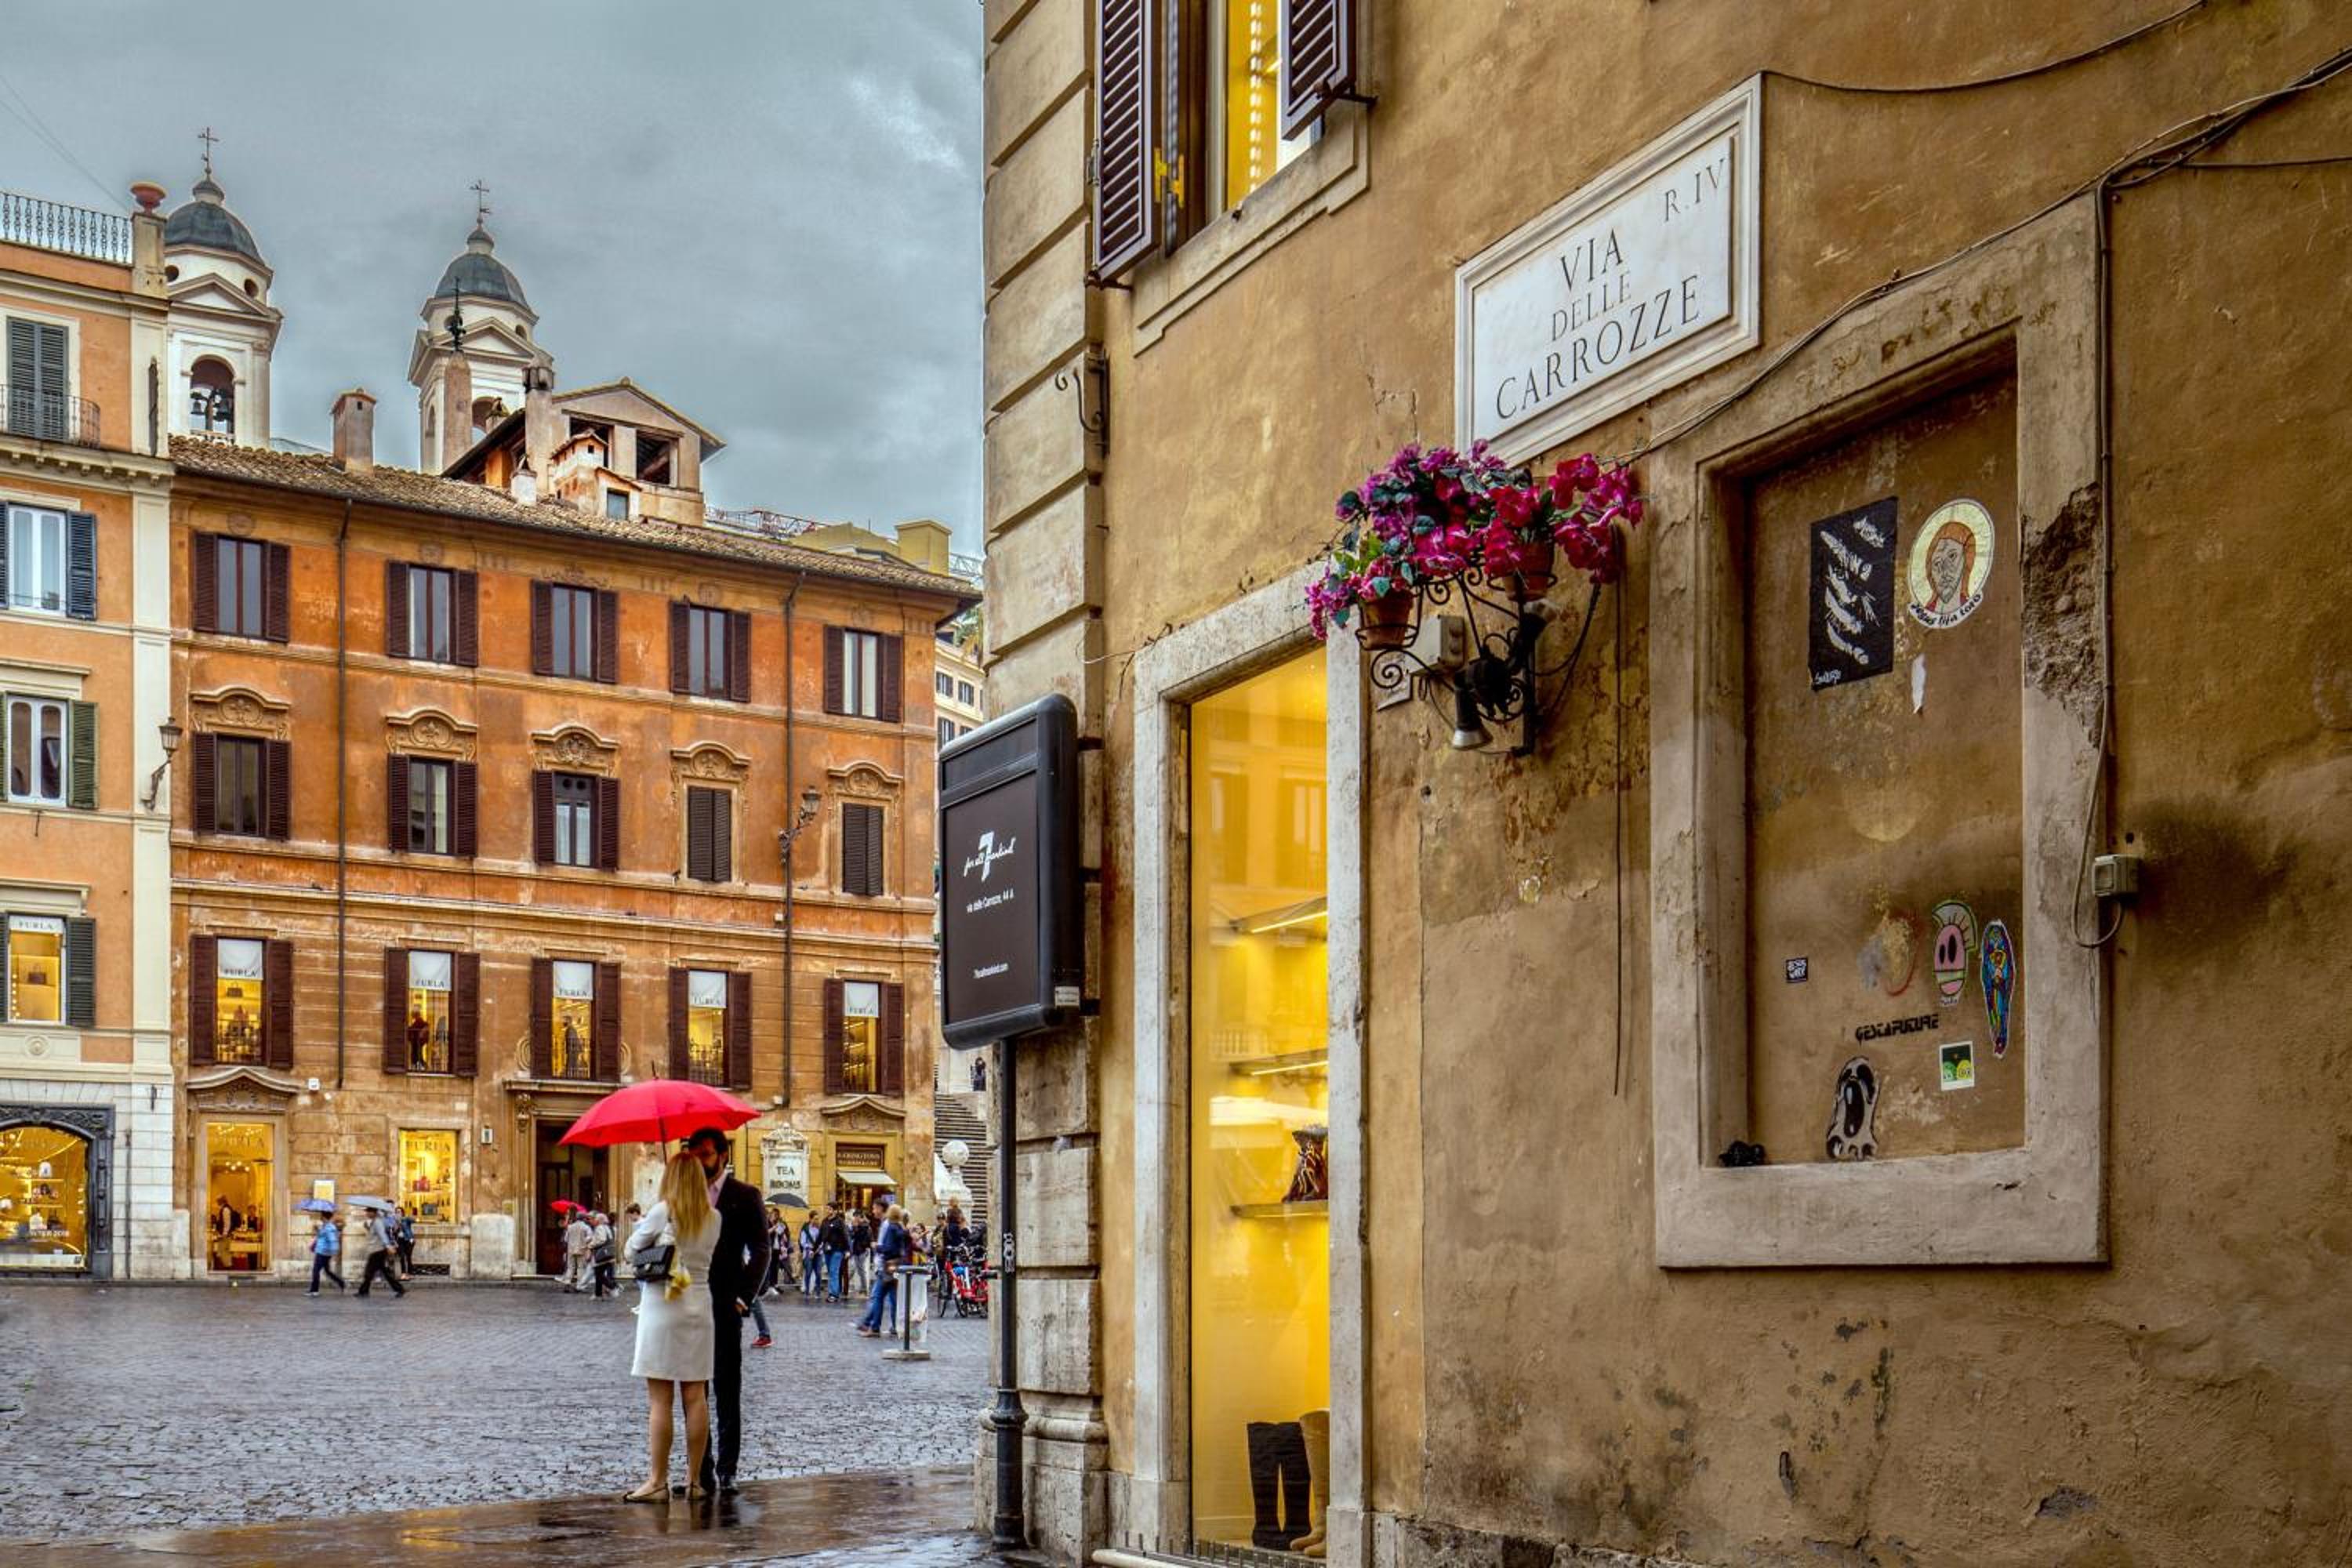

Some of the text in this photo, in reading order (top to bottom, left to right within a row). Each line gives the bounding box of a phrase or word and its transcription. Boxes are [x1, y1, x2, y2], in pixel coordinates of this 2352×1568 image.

[1559, 228, 1624, 291] VIA
[1551, 271, 1632, 341] DELLE
[1497, 274, 1700, 419] CARROZZE
[978, 831, 994, 882] 7
[223, 968, 257, 977] FURLA
[415, 979, 445, 988] FURLA
[559, 988, 588, 996] FURLA
[406, 1141, 451, 1152] FURLA
[776, 1166, 795, 1175] TEA
